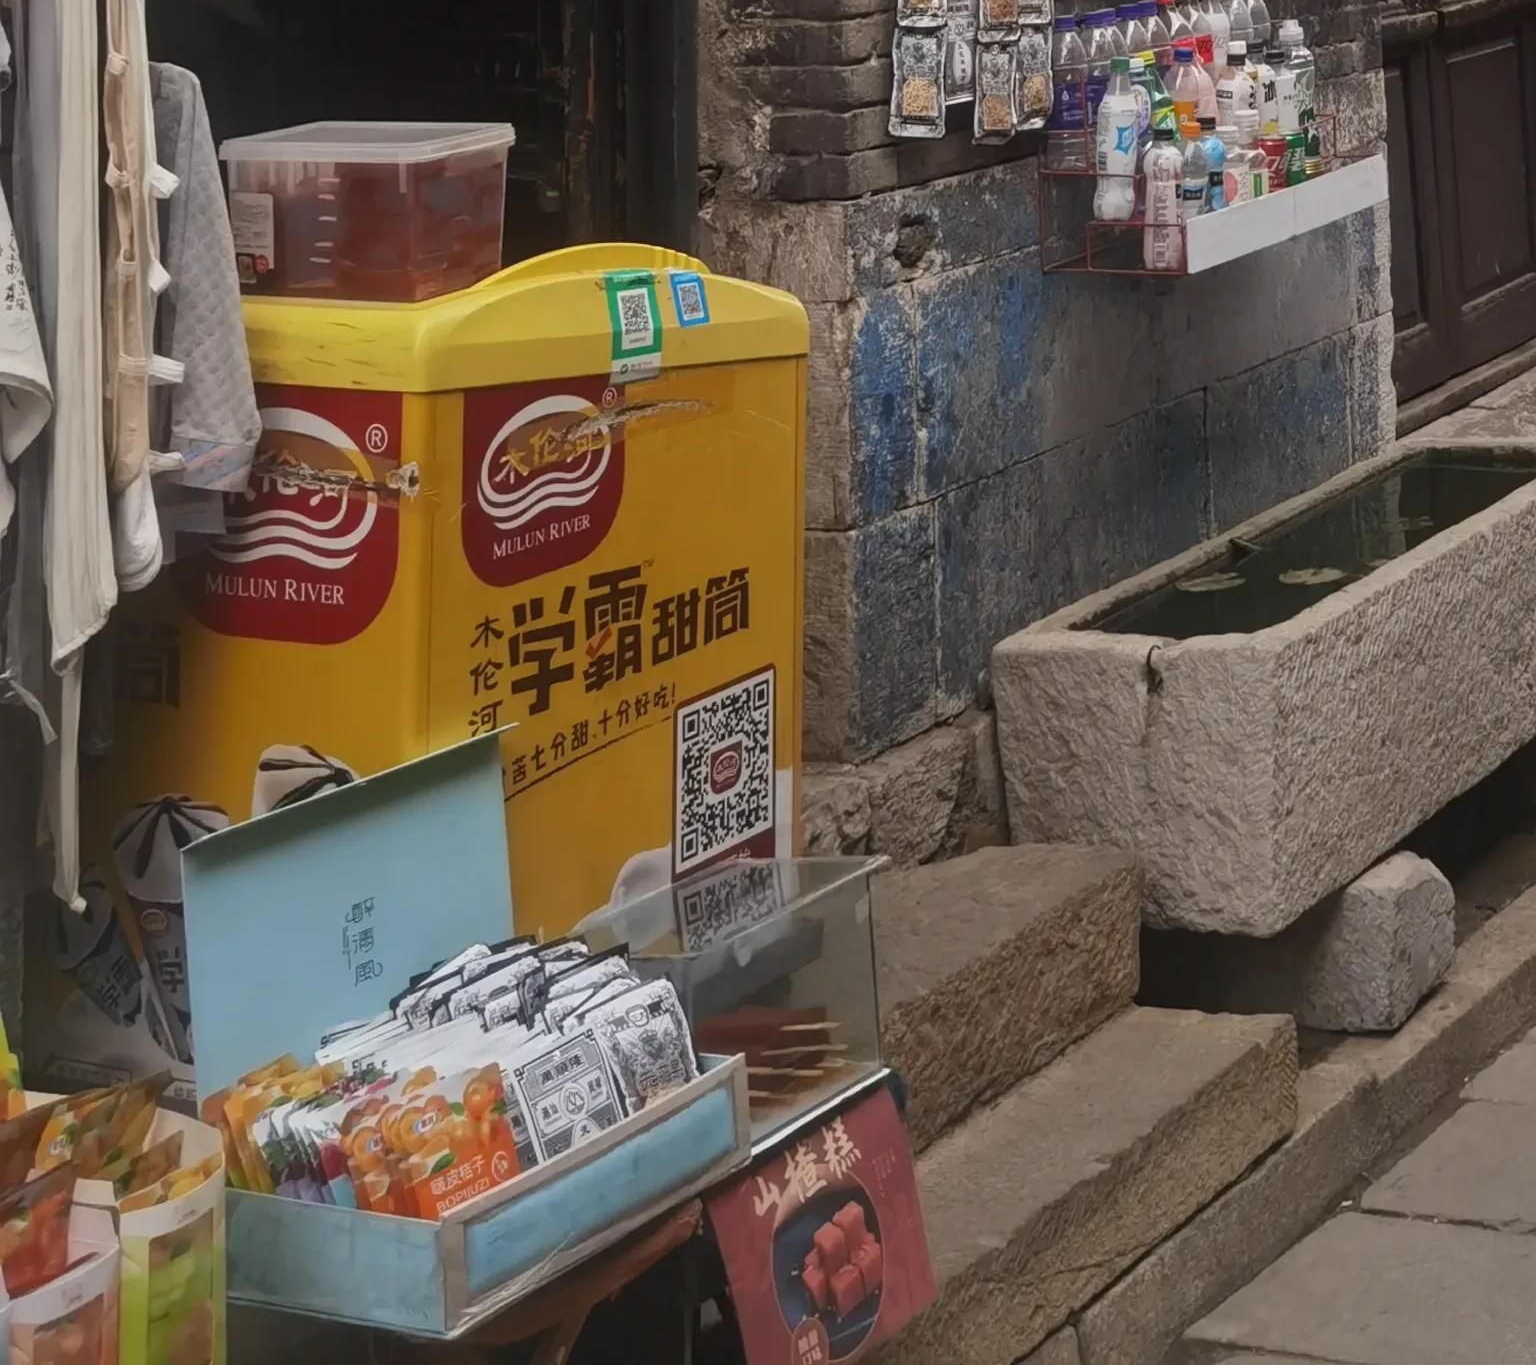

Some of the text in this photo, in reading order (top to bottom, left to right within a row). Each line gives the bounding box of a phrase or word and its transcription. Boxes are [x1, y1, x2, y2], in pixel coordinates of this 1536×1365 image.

[492, 514, 591, 560] MULUN RIVER
[205, 572, 345, 605] MULUN RIVER
[468, 615, 505, 737] 木伦河
[508, 564, 750, 716] 学霸甜筒
[753, 1115, 862, 1217] 山楂糕
